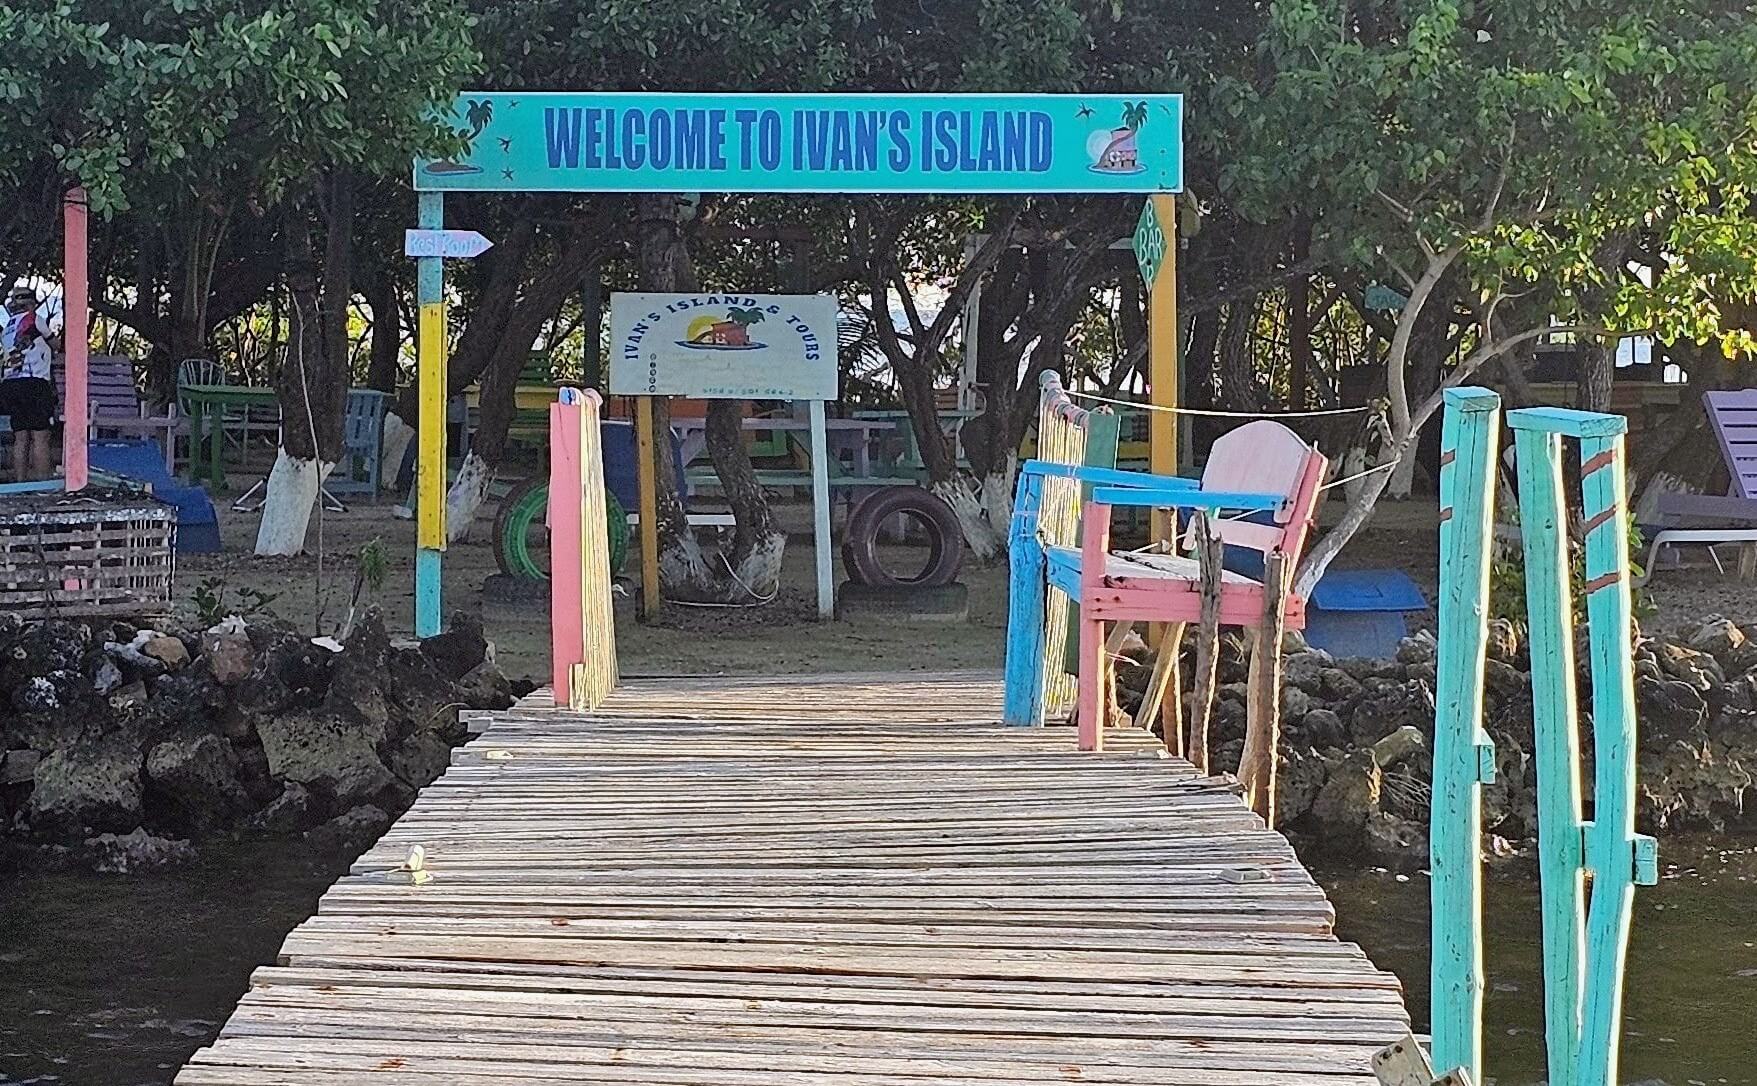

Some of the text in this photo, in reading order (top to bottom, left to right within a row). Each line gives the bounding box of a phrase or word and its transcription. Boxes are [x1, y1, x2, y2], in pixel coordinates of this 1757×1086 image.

[545, 107, 1053, 172] WELCOME TO IVAN'S ISLAND
[1139, 228, 1162, 265] BAR
[625, 296, 820, 361] IVAN'S ISLAND & TOURS
